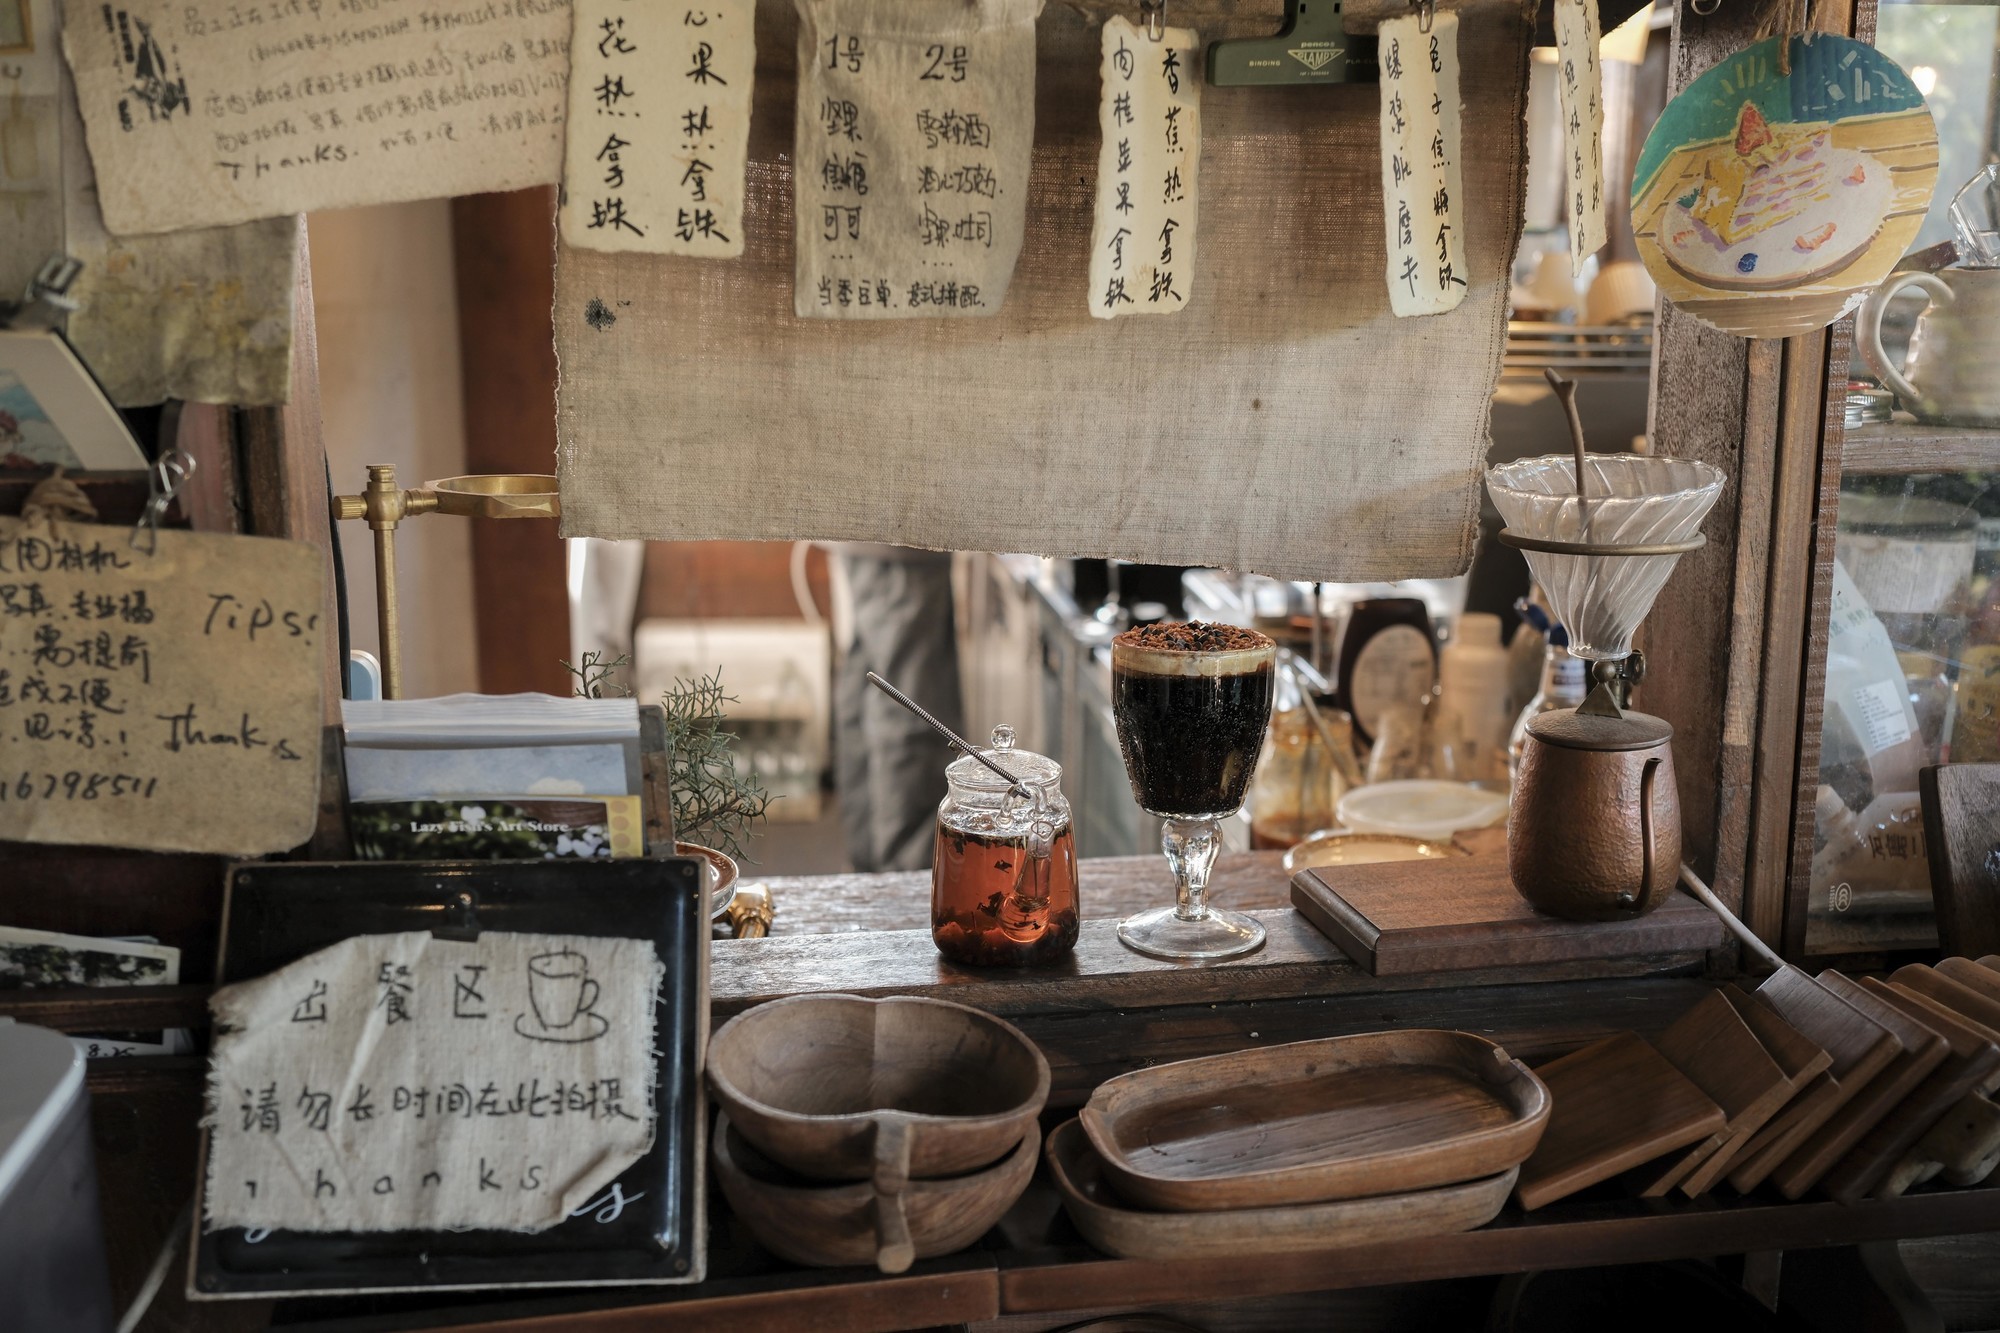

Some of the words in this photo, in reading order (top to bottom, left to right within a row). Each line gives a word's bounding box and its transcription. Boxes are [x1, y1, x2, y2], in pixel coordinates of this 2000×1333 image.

[824, 34, 864, 73] 1号
[919, 44, 968, 83] 2号
[1248, 60, 1281, 68] BINDING
[821, 204, 862, 241] 可可
[156, 703, 301, 760] Thanks
[410, 821, 443, 834] Lazy
[498, 820, 522, 832] Art
[527, 821, 569, 833] Store
